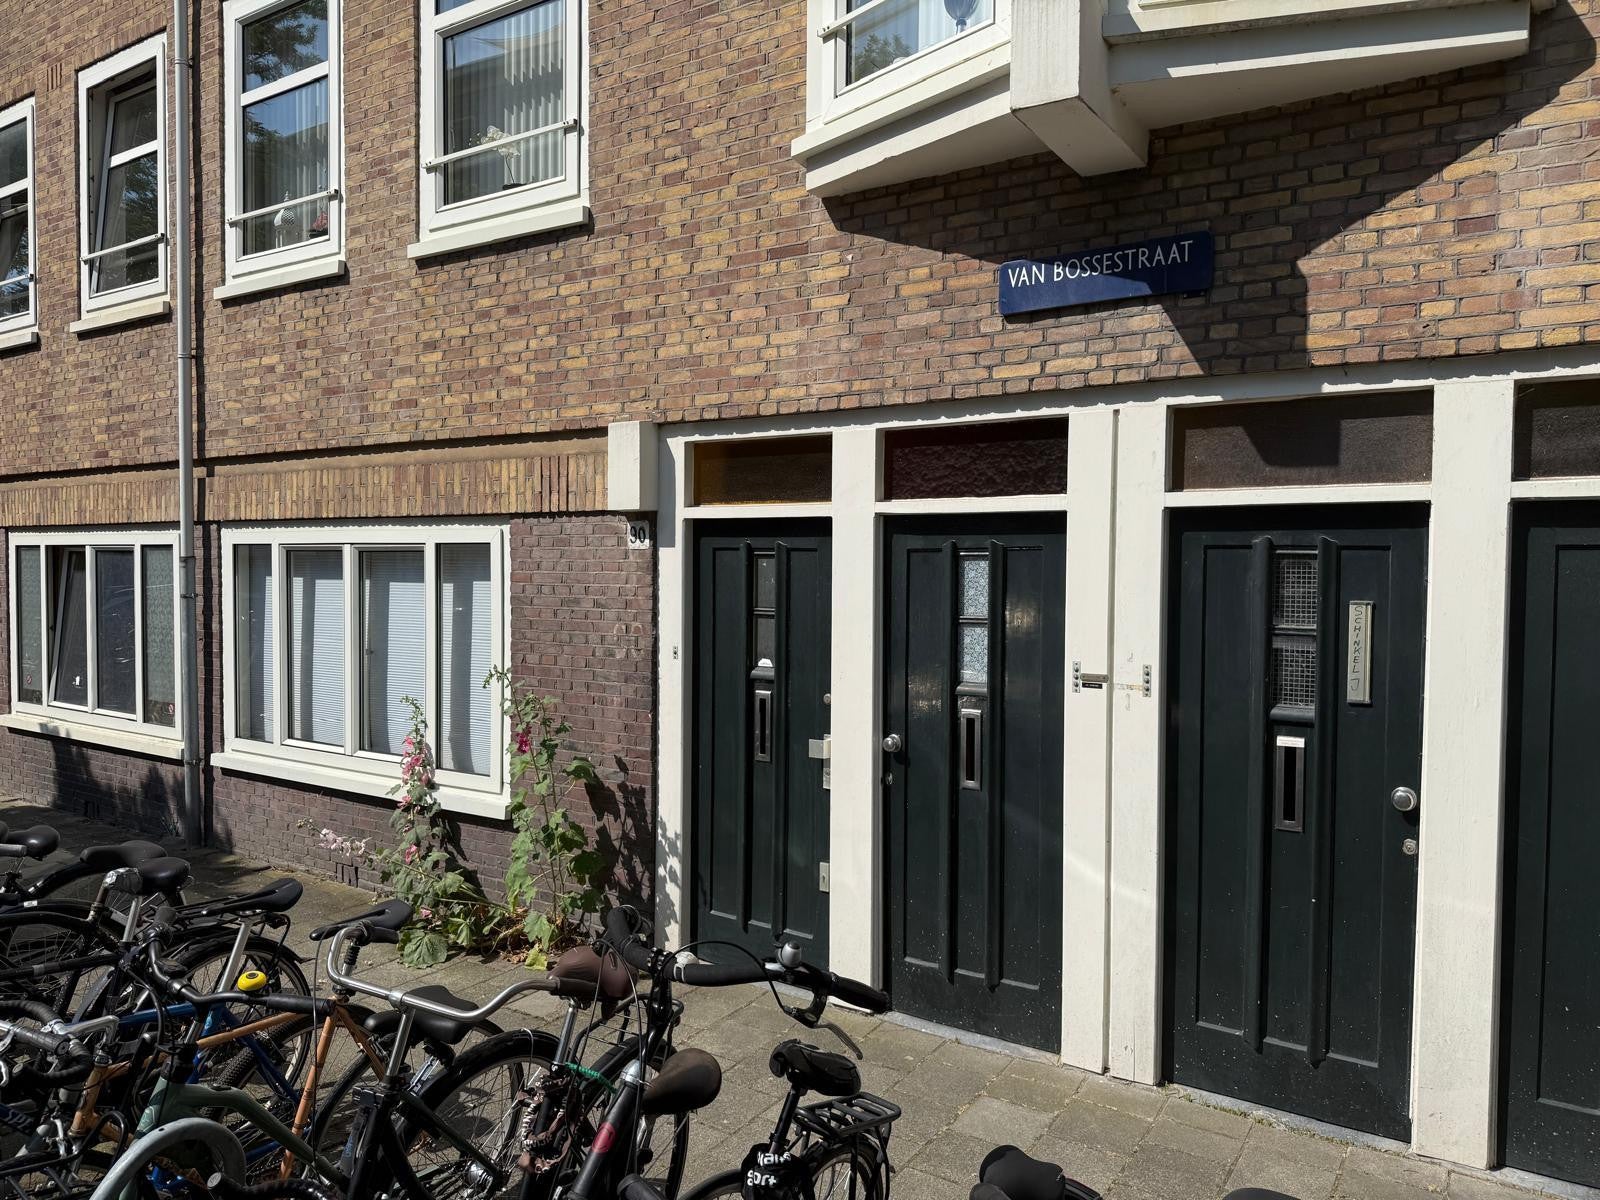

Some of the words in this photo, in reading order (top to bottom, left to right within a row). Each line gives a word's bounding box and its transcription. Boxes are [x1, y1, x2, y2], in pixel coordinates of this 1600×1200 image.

[1008, 263, 1045, 288] VAN
[1053, 240, 1193, 282] BOSSESTRAAT
[630, 526, 646, 544] 90
[1353, 605, 1363, 674] SCHINKEL
